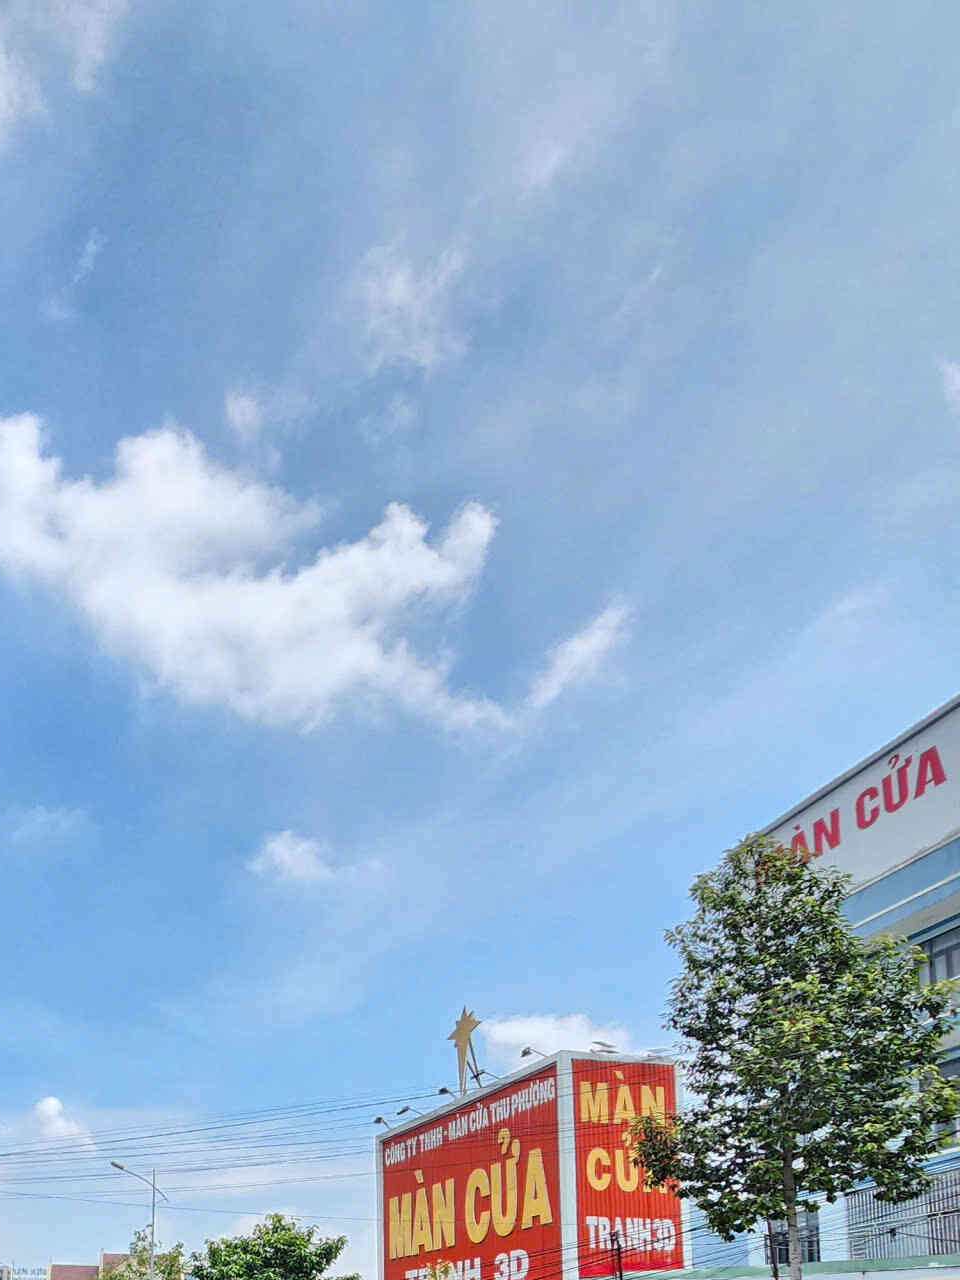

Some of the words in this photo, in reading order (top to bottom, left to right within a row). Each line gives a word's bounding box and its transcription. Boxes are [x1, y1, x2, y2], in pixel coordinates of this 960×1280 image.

[855, 745, 947, 830] CỬA
[579, 1070, 666, 1127] MÀN
[384, 1142, 406, 1166] CÔNG
[407, 1136, 418, 1158] TY
[419, 1126, 444, 1152] TNHH
[448, 1113, 469, 1141] MÀN
[469, 1103, 489, 1132] CỬA
[388, 1168, 456, 1260] MÀN
[464, 1127, 554, 1244] CỬA
[585, 1215, 652, 1252] TRANH
[653, 1218, 676, 1253] 3D
